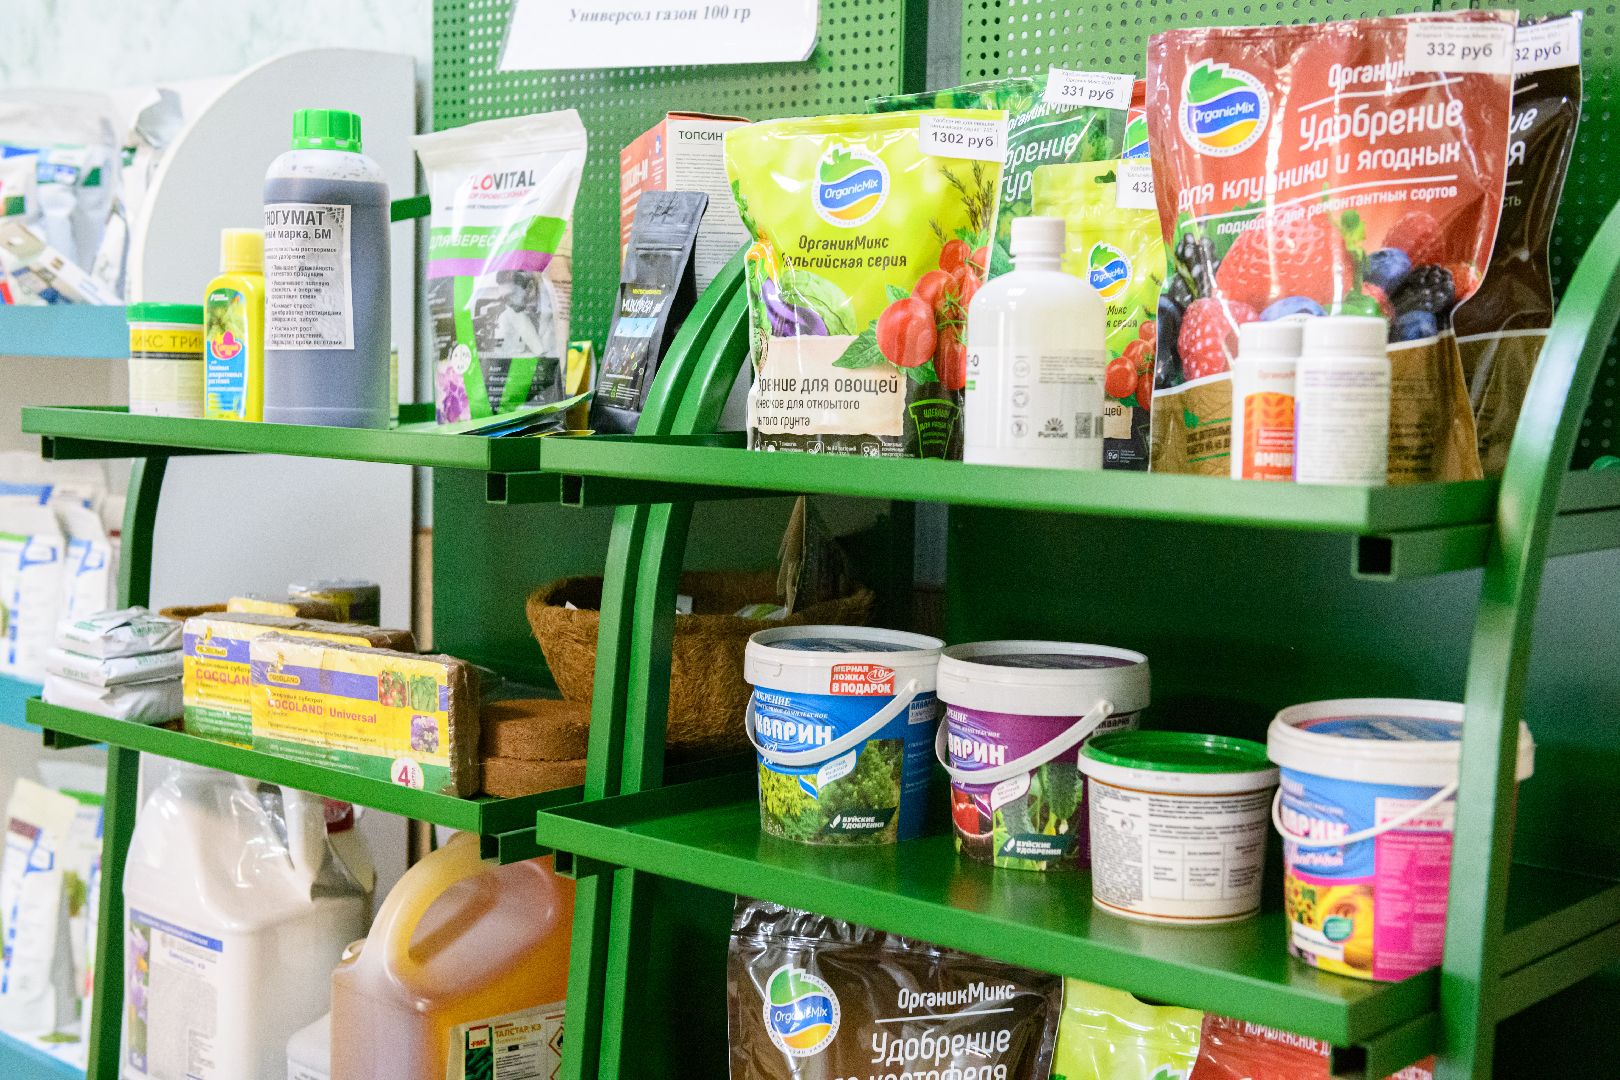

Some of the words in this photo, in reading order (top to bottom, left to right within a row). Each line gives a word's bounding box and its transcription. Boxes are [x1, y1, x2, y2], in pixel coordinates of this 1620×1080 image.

[568, 8, 651, 25] Универсол
[655, 8, 698, 21] газон
[702, 5, 729, 20] 100
[733, 7, 751, 23] гр
[1426, 42, 1456, 56] 332
[1461, 43, 1493, 60] руб
[1534, 42, 1562, 61] руб
[1061, 85, 1084, 97] 331
[1088, 88, 1114, 101] руб
[1298, 98, 1465, 152] Удобрение
[678, 130, 723, 141] ТОПСИН
[932, 131, 964, 145] 1302
[968, 136, 994, 149] руб
[1178, 181, 1215, 213] для
[1221, 156, 1329, 204] клуники
[1334, 152, 1350, 175] и
[1356, 140, 1462, 172] ягодных
[824, 178, 879, 200] OrganicMix
[1306, 188, 1408, 223] ремонтантных
[1409, 184, 1458, 204] сортов
[314, 228, 332, 239] БМ
[798, 234, 890, 253] ОрганикМикс
[867, 254, 907, 271] серия
[800, 379, 829, 394] для
[834, 375, 898, 395] овощей
[786, 400, 804, 411] для
[806, 399, 860, 411] открытого
[780, 416, 811, 430] грунта
[832, 673, 866, 681] ЛОЖКА
[831, 683, 840, 693] В
[840, 683, 892, 694] ПОДАРОК
[329, 707, 378, 724] Universal
[397, 764, 411, 787] 4
[841, 822, 885, 830] УДОБРЕНИЯ
[1016, 840, 1052, 849] БУЙСКИЕ
[1016, 847, 1062, 855] УДОБРЕНИЯ
[897, 981, 1016, 1010] ОрганикМикс
[871, 1027, 1011, 1067] Удобрение
